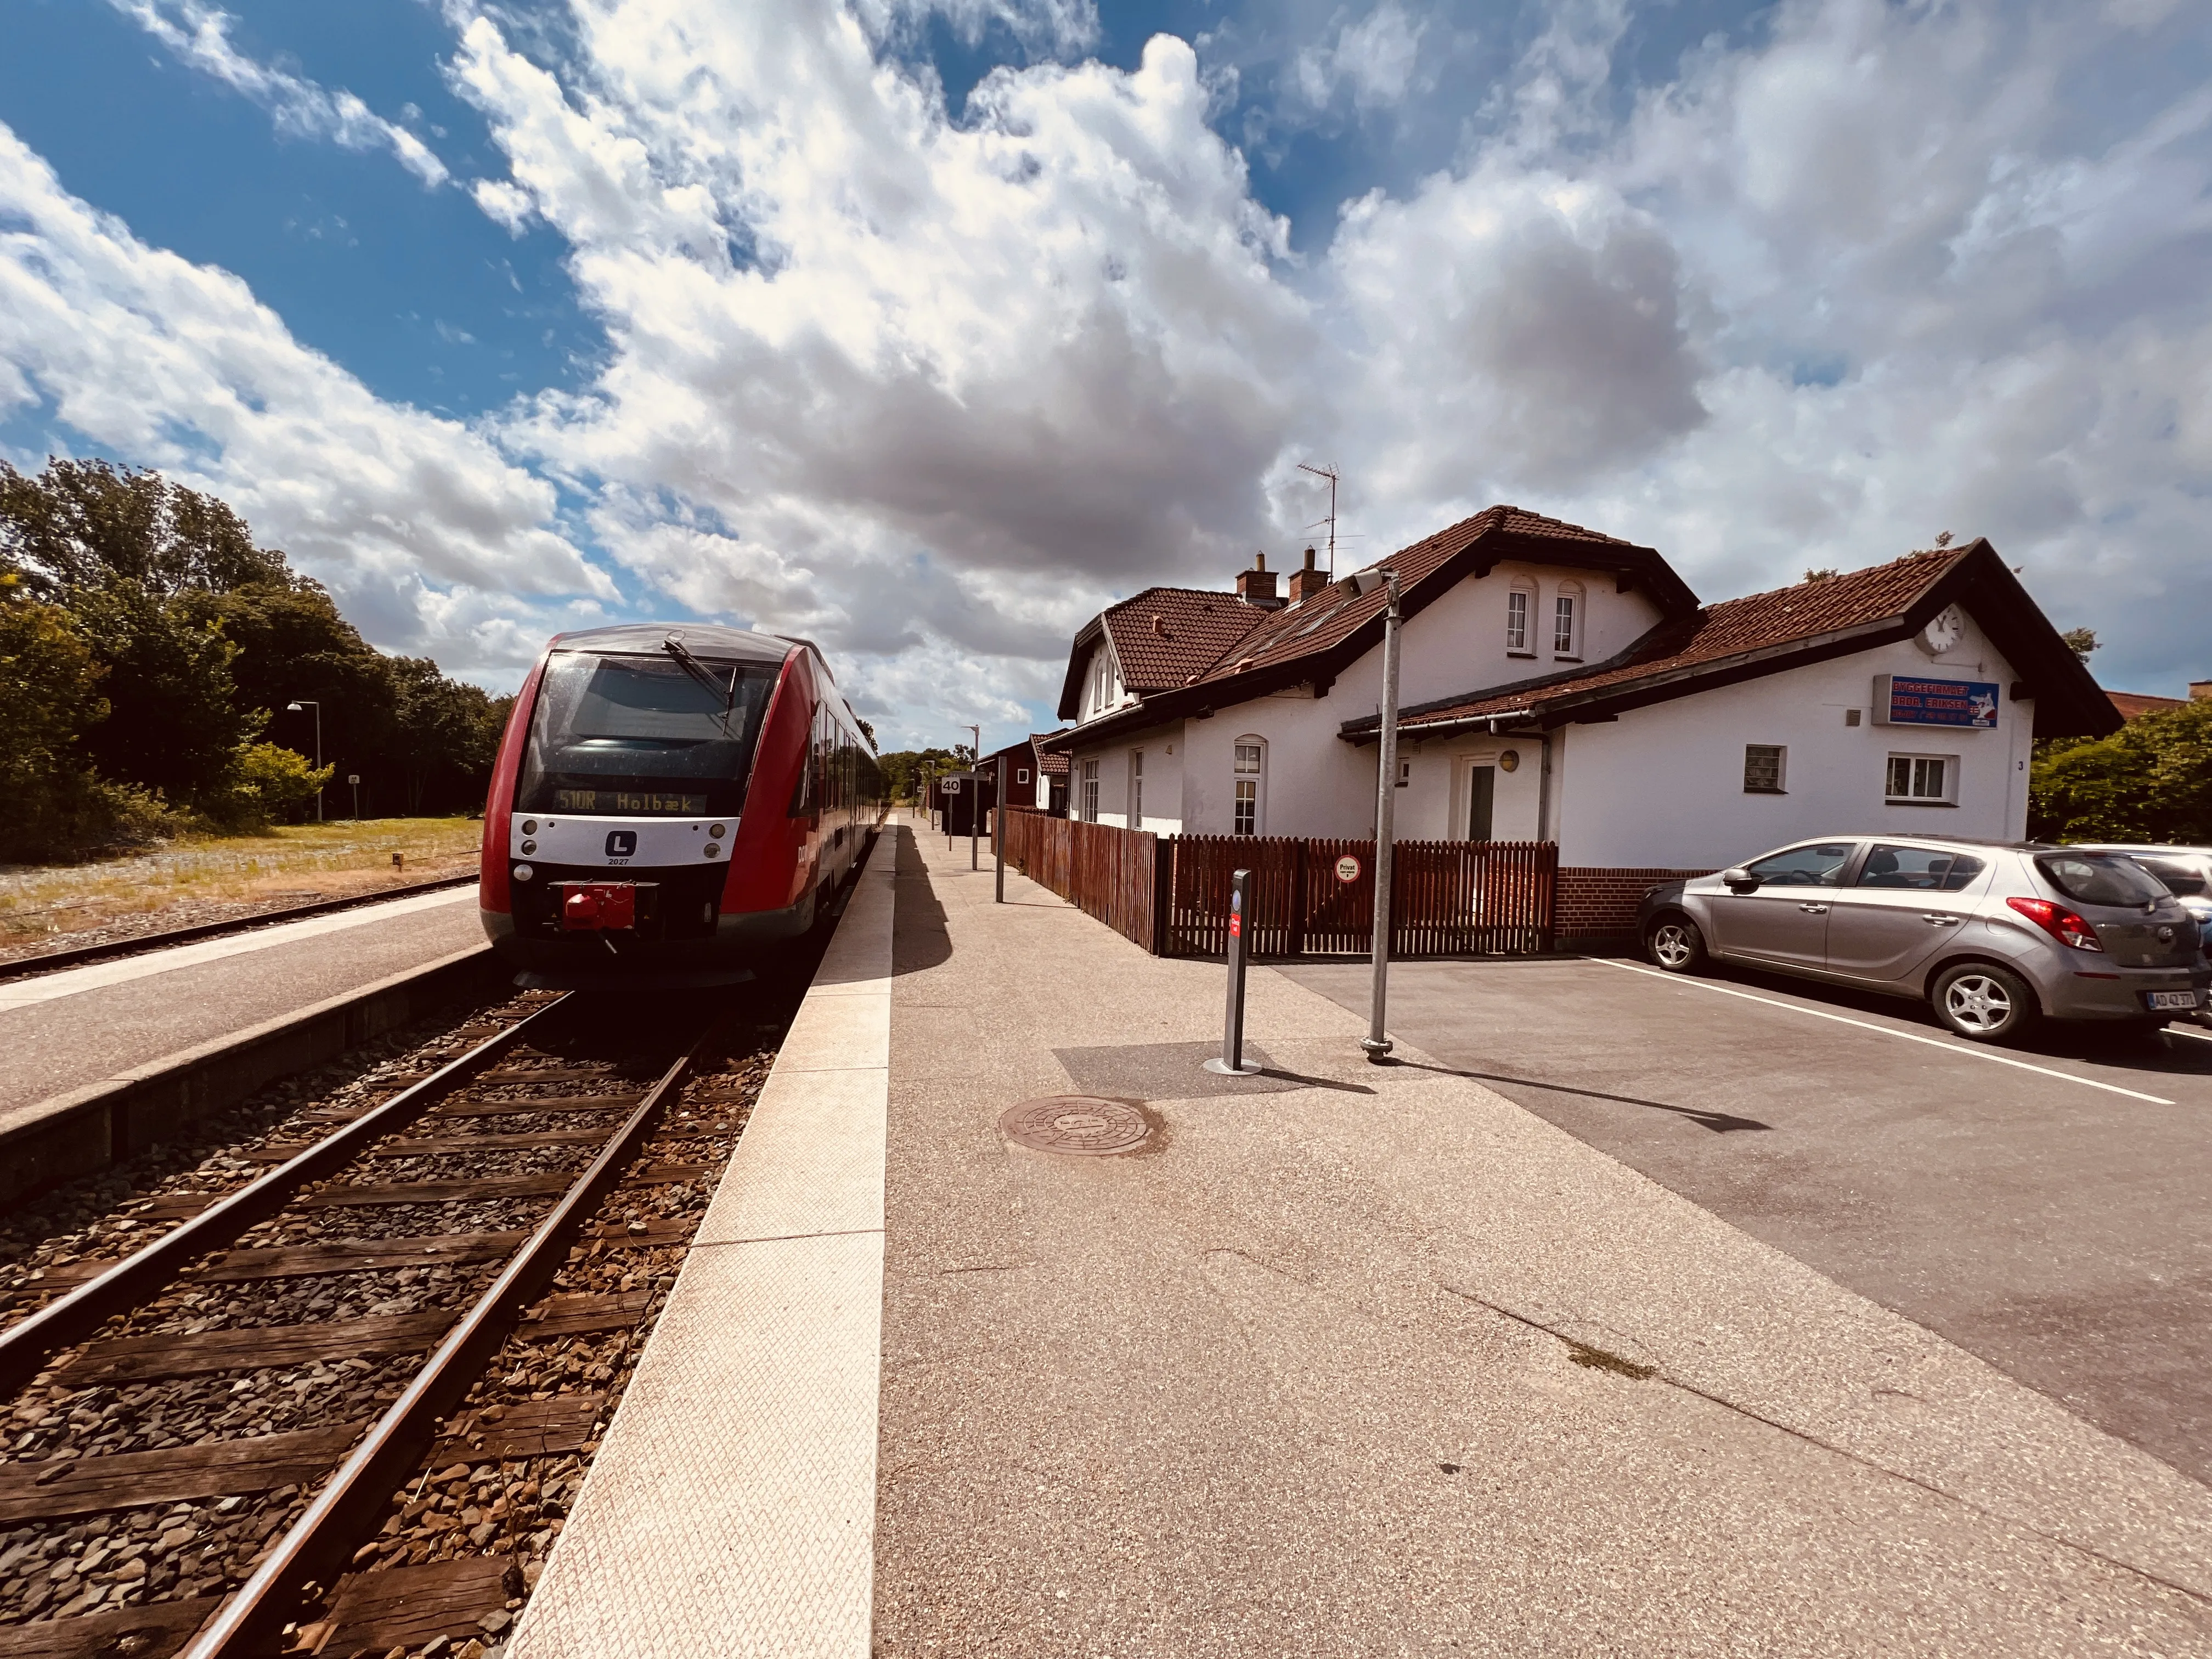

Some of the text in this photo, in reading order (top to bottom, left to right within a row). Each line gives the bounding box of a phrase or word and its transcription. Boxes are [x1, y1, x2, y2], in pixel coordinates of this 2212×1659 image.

[1893, 681, 1970, 696] BYGGEFIRMAET
[1892, 696, 1968, 709] BRDR. ERIKSEN
[2018, 761, 2023, 770] 3
[943, 781, 960, 791] 40
[617, 793, 691, 811] Holbæk
[613, 836, 628, 851] L
